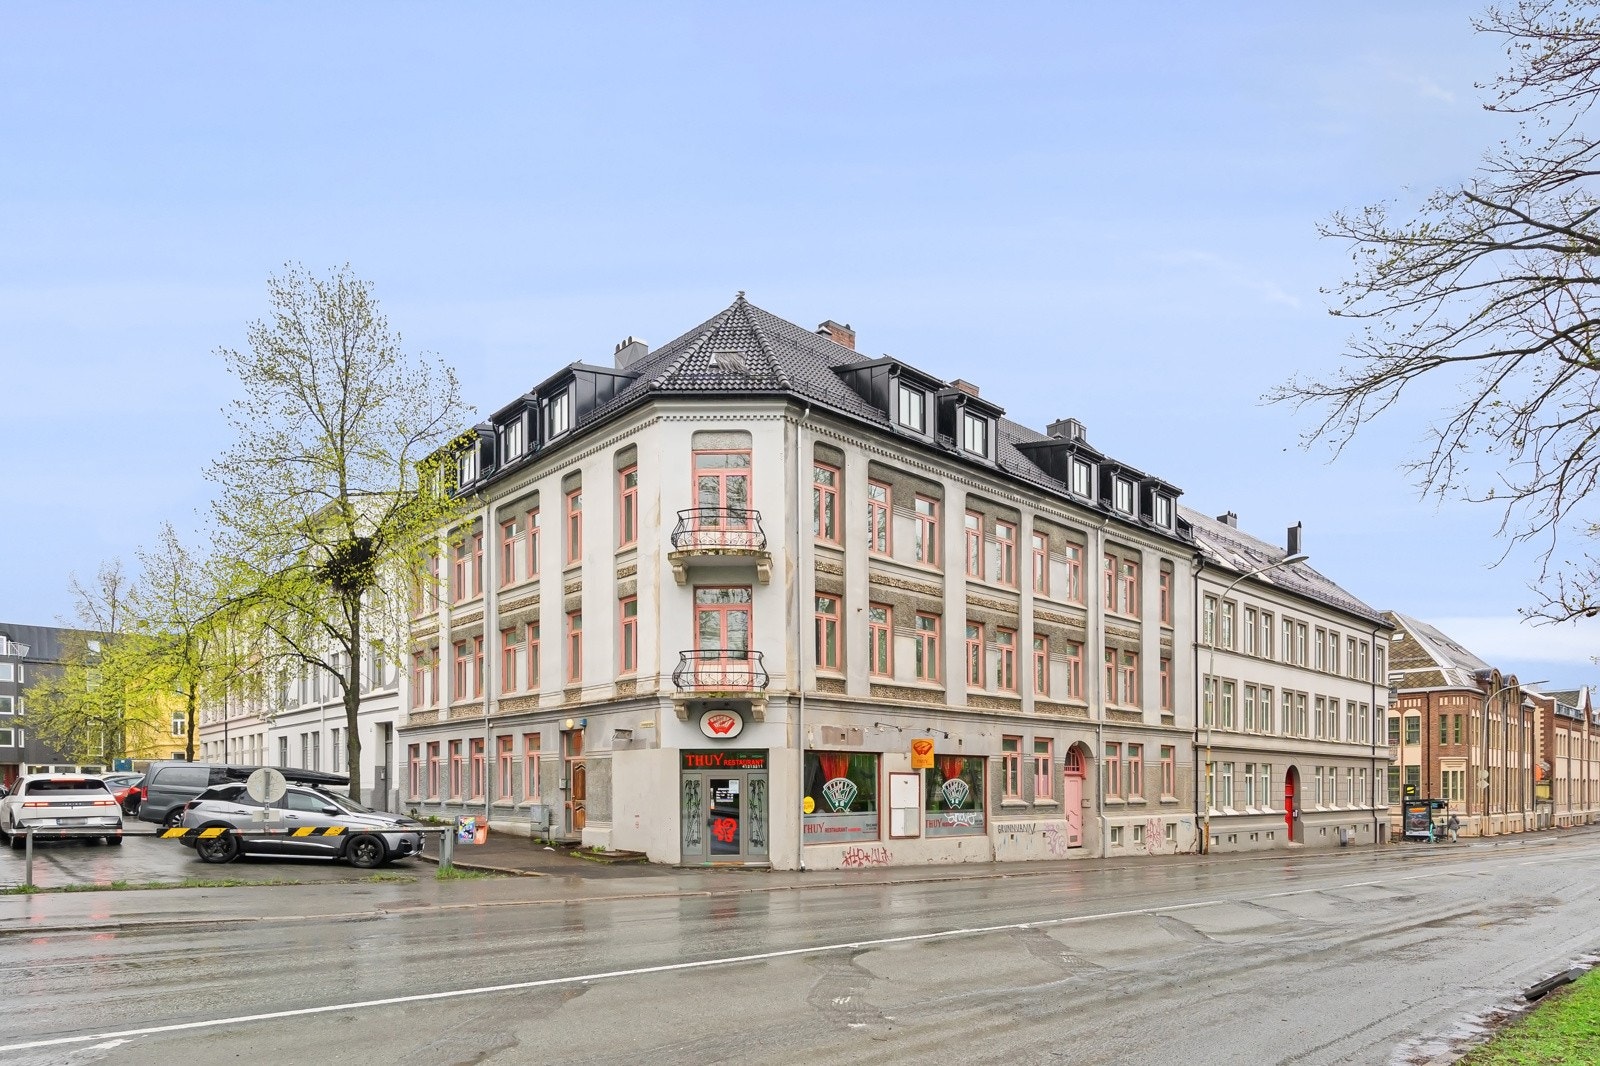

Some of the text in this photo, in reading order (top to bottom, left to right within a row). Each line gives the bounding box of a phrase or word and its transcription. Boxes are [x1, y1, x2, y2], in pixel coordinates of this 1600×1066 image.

[685, 752, 724, 767] THUY
[724, 759, 764, 767] RESTAURANT
[803, 822, 825, 834] THUY
